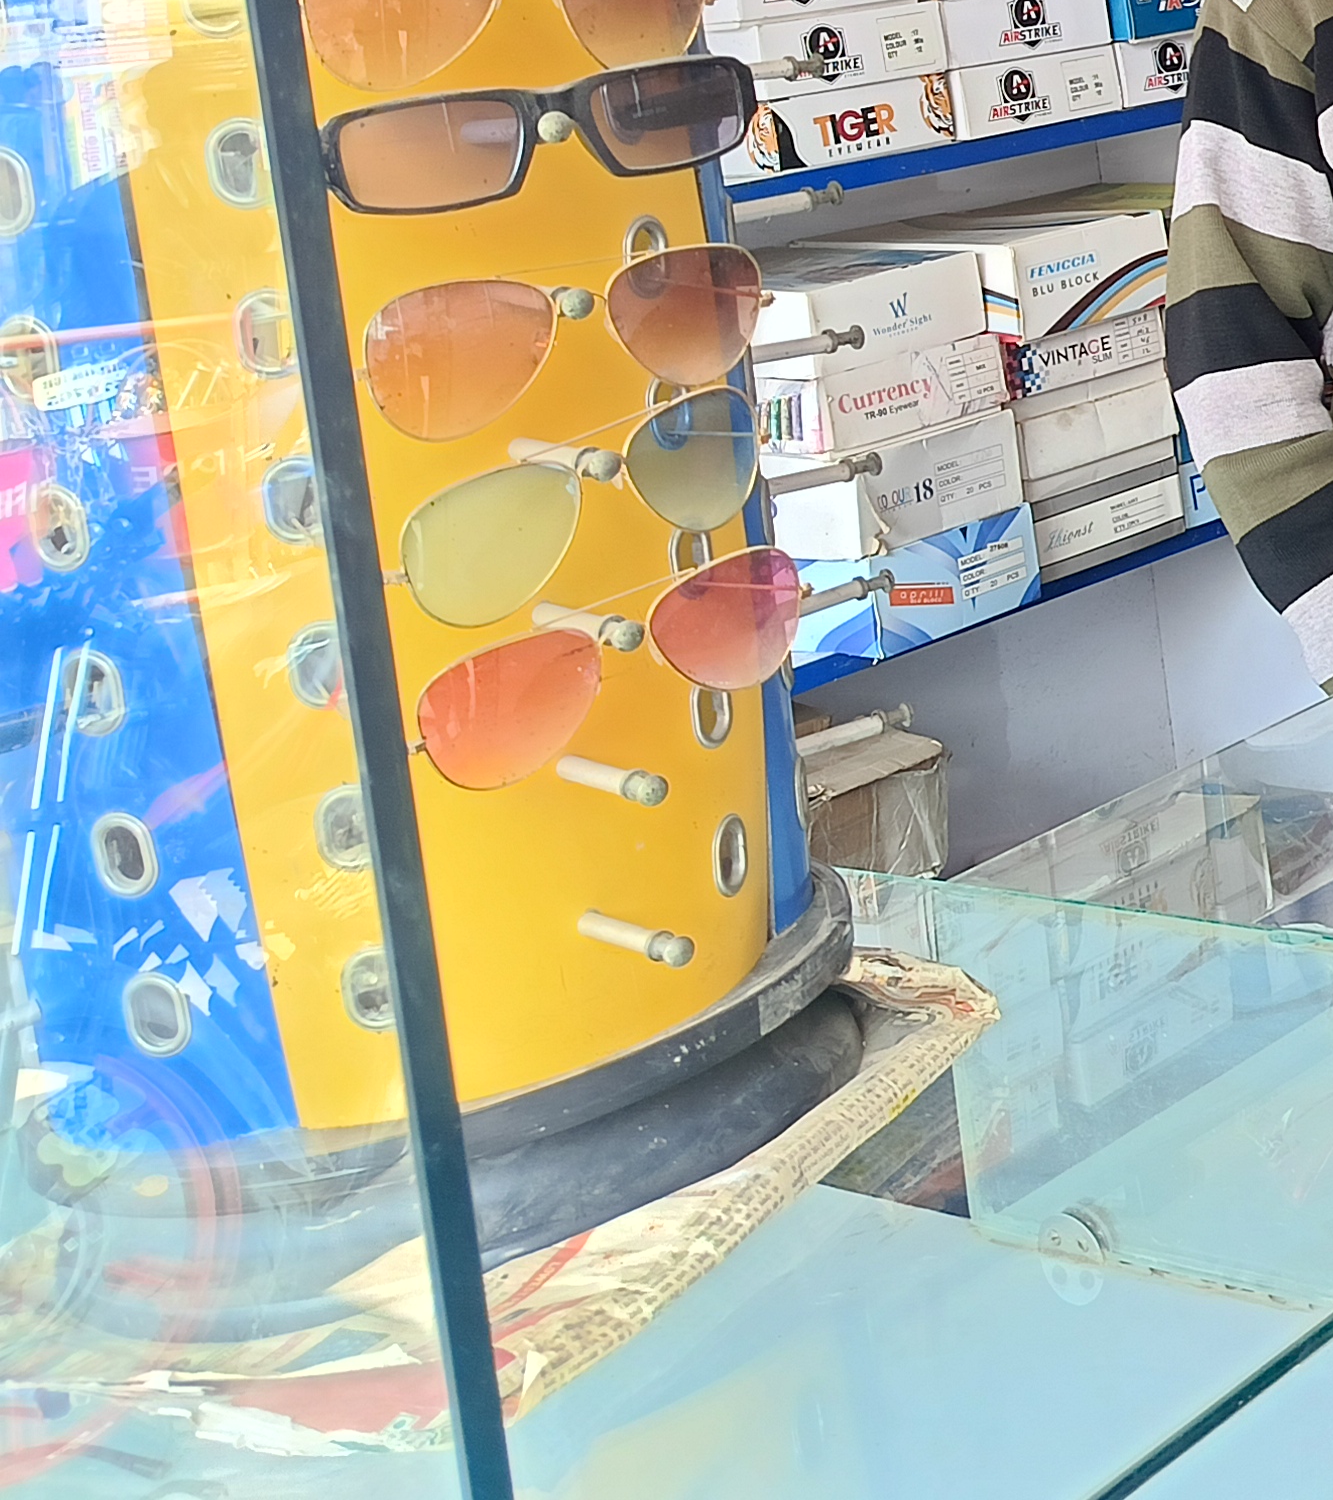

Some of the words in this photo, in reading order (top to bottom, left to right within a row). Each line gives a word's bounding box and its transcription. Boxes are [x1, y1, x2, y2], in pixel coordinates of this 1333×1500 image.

[1001, 24, 1062, 44] AIRSTRIKE
[990, 97, 1050, 119] AIRSTRIKE
[813, 104, 897, 145] TIGER
[828, 137, 891, 157] EYEWEAR
[1029, 253, 1095, 279] FENICCIA
[1032, 282, 1055, 297] BLU
[1060, 271, 1100, 290] BLOCK
[872, 319, 907, 337] Wonder
[909, 313, 932, 329] Sight
[1038, 335, 1111, 368] VINTAGE
[1092, 351, 1113, 364] SLIM
[837, 376, 933, 414] Currency
[864, 404, 888, 420] TR-90
[889, 399, 920, 415] Eyewear
[913, 478, 934, 503] 18
